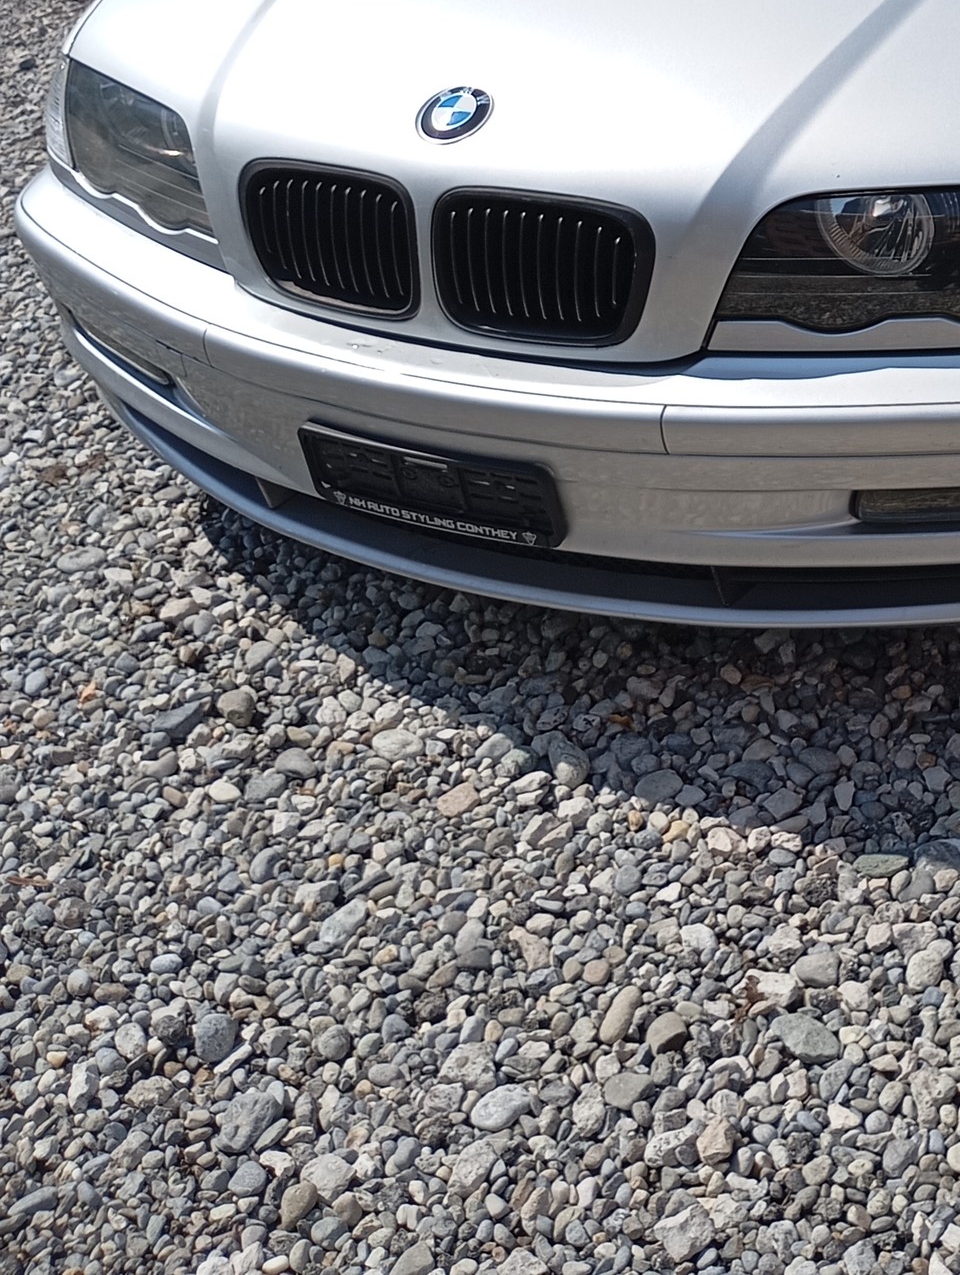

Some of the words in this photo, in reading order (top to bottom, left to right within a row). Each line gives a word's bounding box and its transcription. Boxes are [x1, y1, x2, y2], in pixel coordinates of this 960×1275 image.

[368, 501, 401, 517] AUTO
[401, 510, 456, 530] STYLING
[456, 521, 518, 540] CONTHEY
